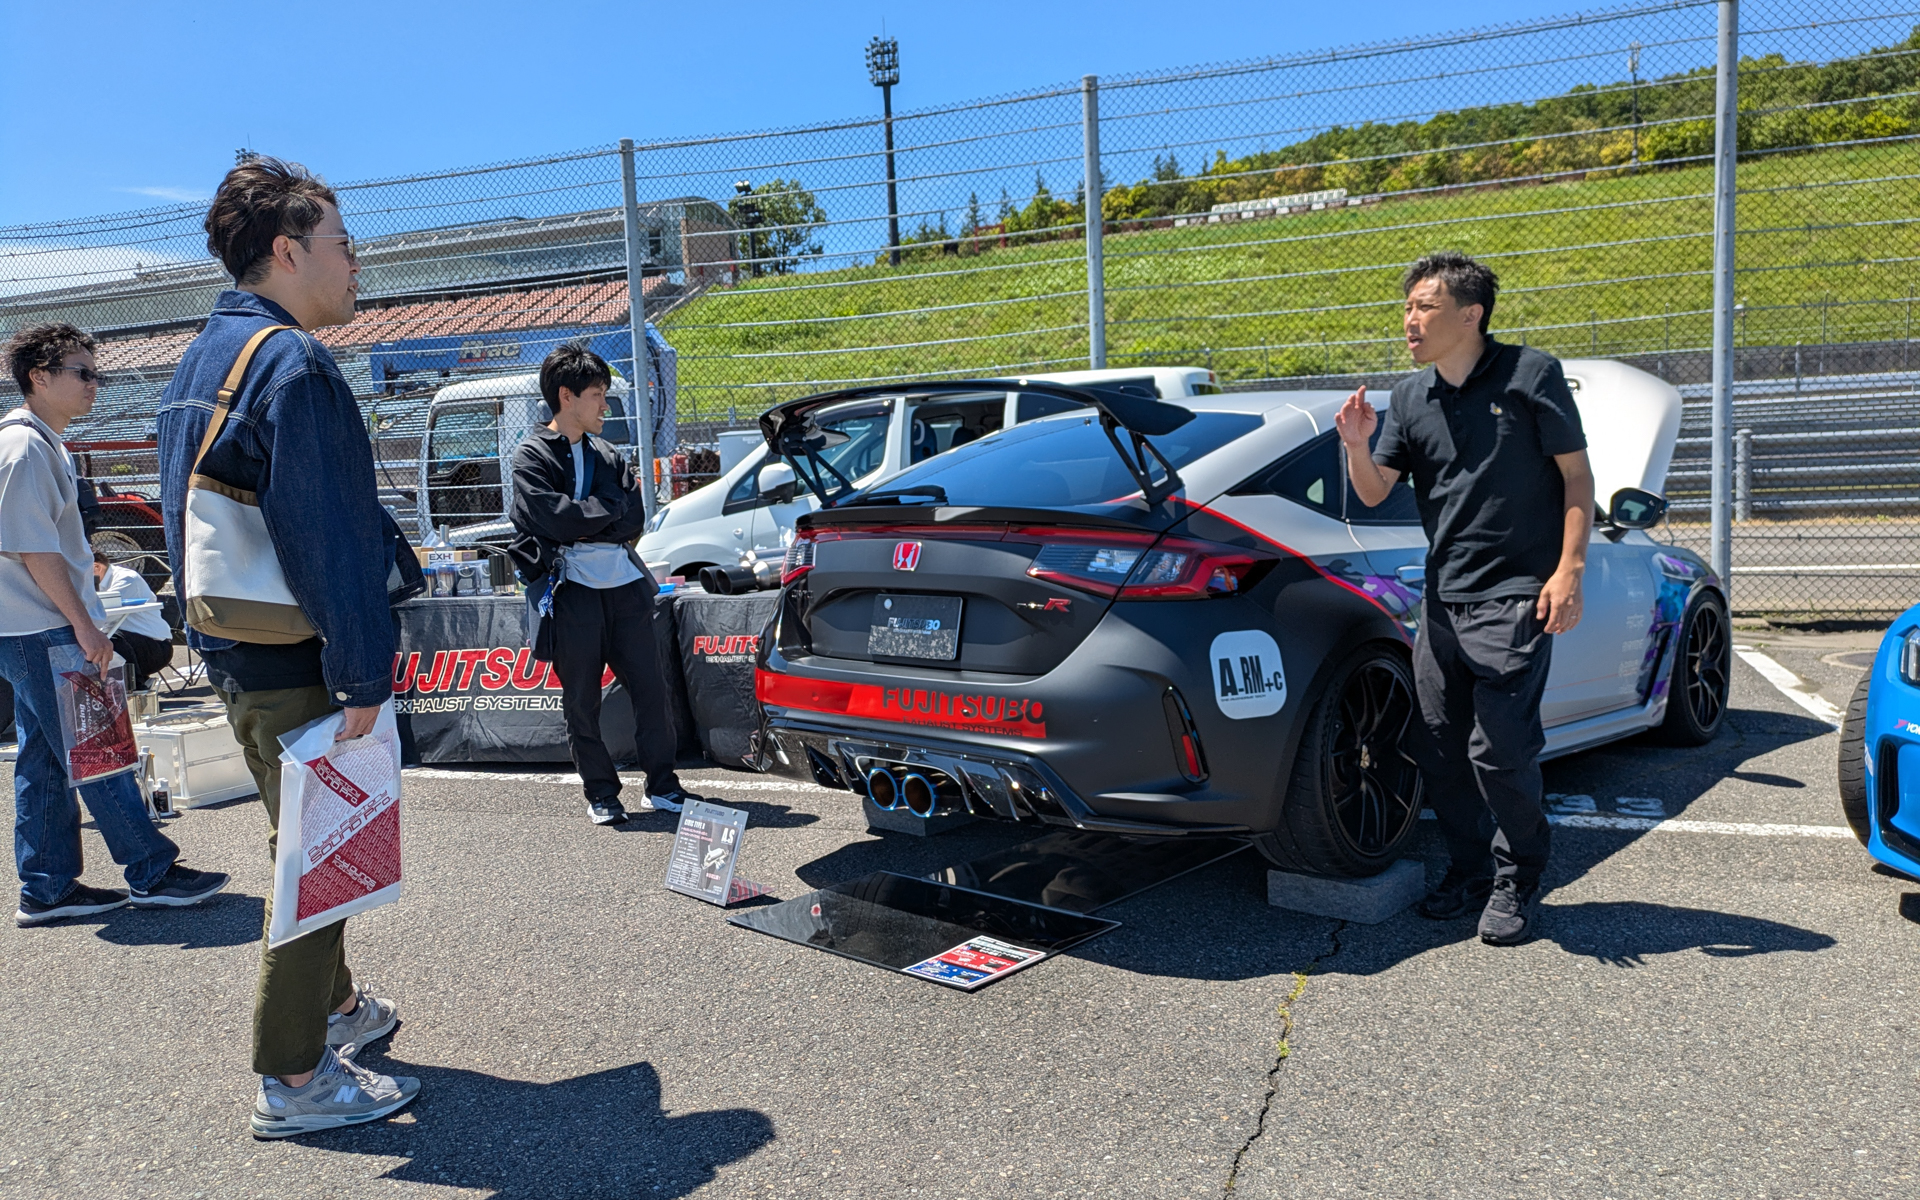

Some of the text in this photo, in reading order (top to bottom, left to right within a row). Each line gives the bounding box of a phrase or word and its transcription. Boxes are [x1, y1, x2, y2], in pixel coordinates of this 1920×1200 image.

[882, 687, 1046, 725] FUJITSUBO
[902, 716, 1024, 737] EXHAUST SYSTEMS
[333, 1085, 359, 1104] N
